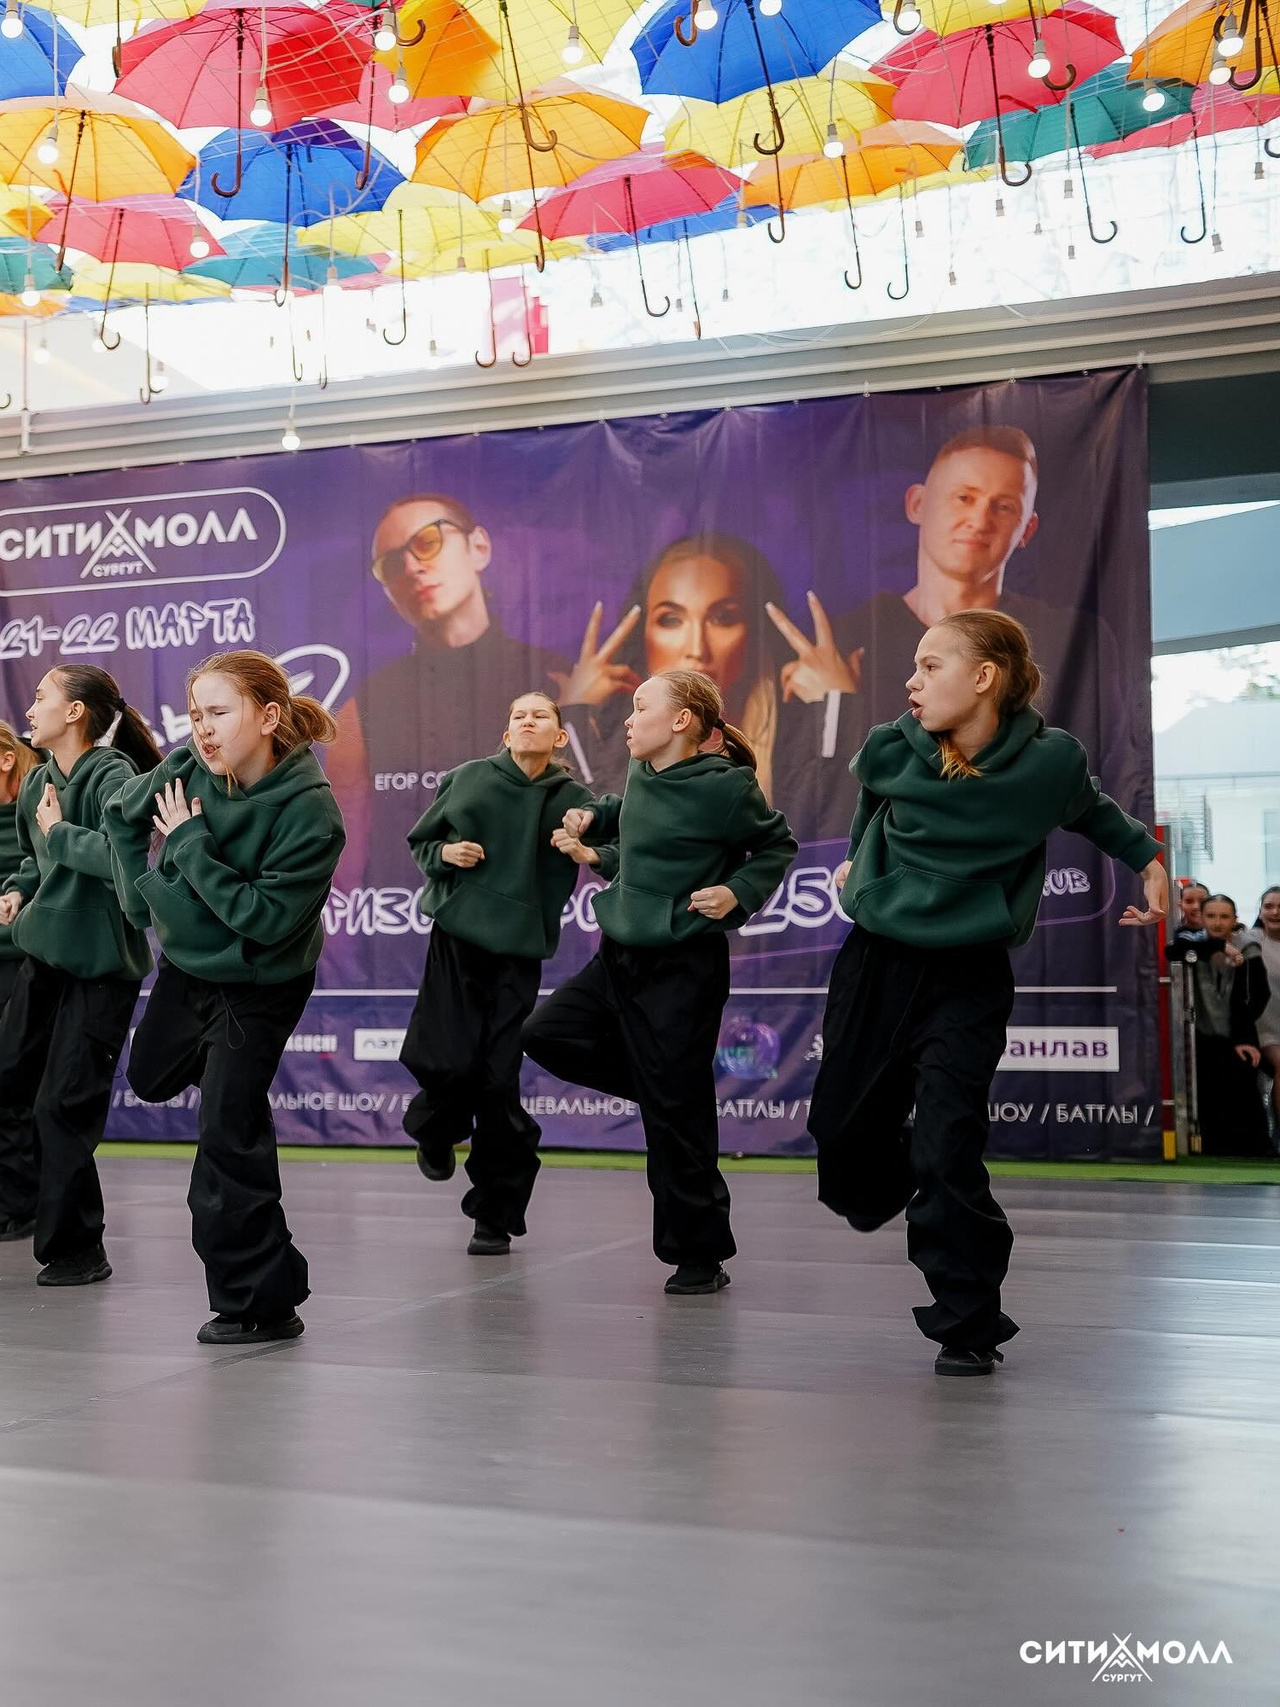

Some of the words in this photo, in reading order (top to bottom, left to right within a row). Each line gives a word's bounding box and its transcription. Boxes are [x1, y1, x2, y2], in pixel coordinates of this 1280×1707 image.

[91, 561, 143, 578] СУРГУТ
[125, 597, 256, 650] МАРТА
[374, 771, 419, 791] ЕГОР
[1005, 1039, 1110, 1059] анлав
[338, 1092, 386, 1112] ШОУ
[1056, 1103, 1138, 1124] БАТТЛЫ
